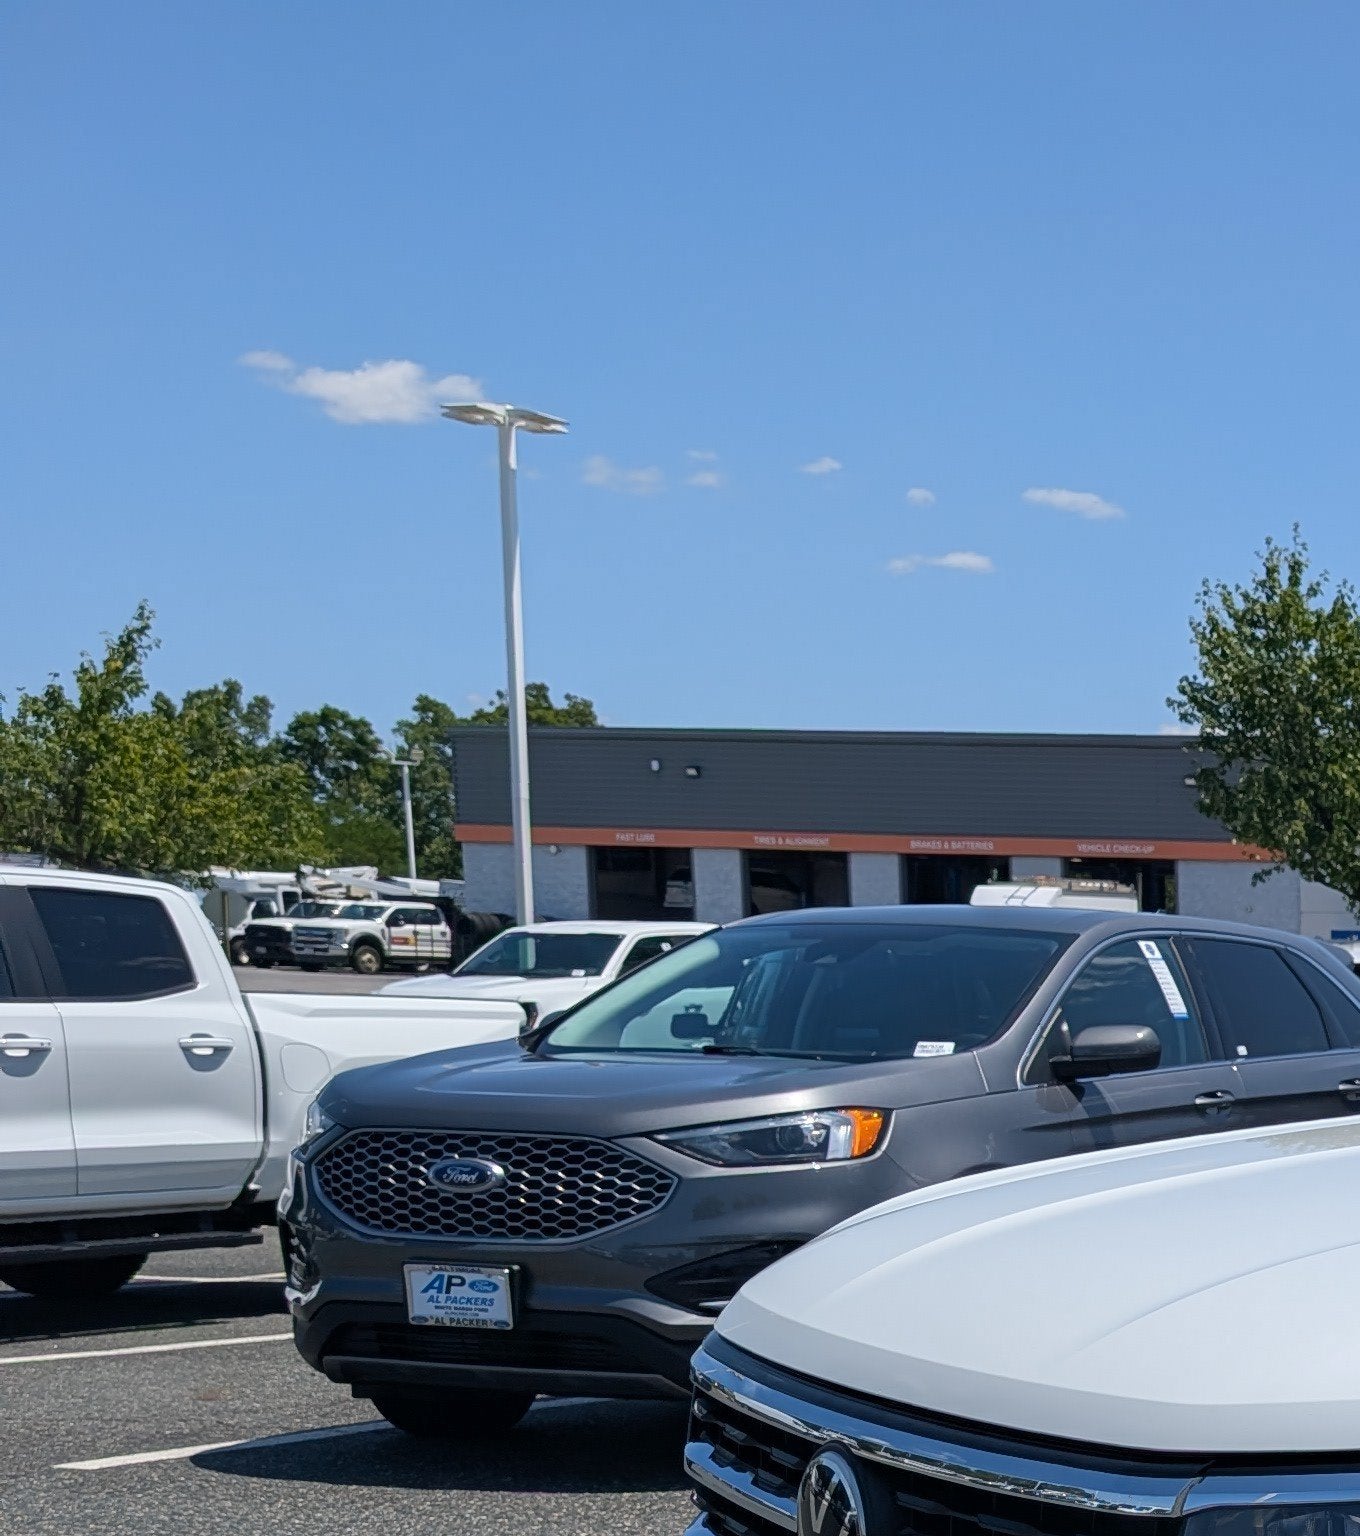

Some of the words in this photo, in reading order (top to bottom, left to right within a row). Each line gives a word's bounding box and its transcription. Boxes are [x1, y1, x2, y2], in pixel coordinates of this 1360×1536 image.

[615, 833, 635, 842] FAST
[754, 836, 776, 845] TIRES
[785, 837, 830, 846] ALIGNMENT
[909, 840, 942, 850] BRAKES
[951, 841, 994, 851] BATTERIES
[1077, 844, 1111, 853] VEHICLE
[1112, 845, 1155, 854] CHECK-UP
[442, 1166, 480, 1184] Ford
[420, 1273, 467, 1295] AP
[427, 1295, 442, 1304] AL
[444, 1296, 495, 1307] PACKERS
